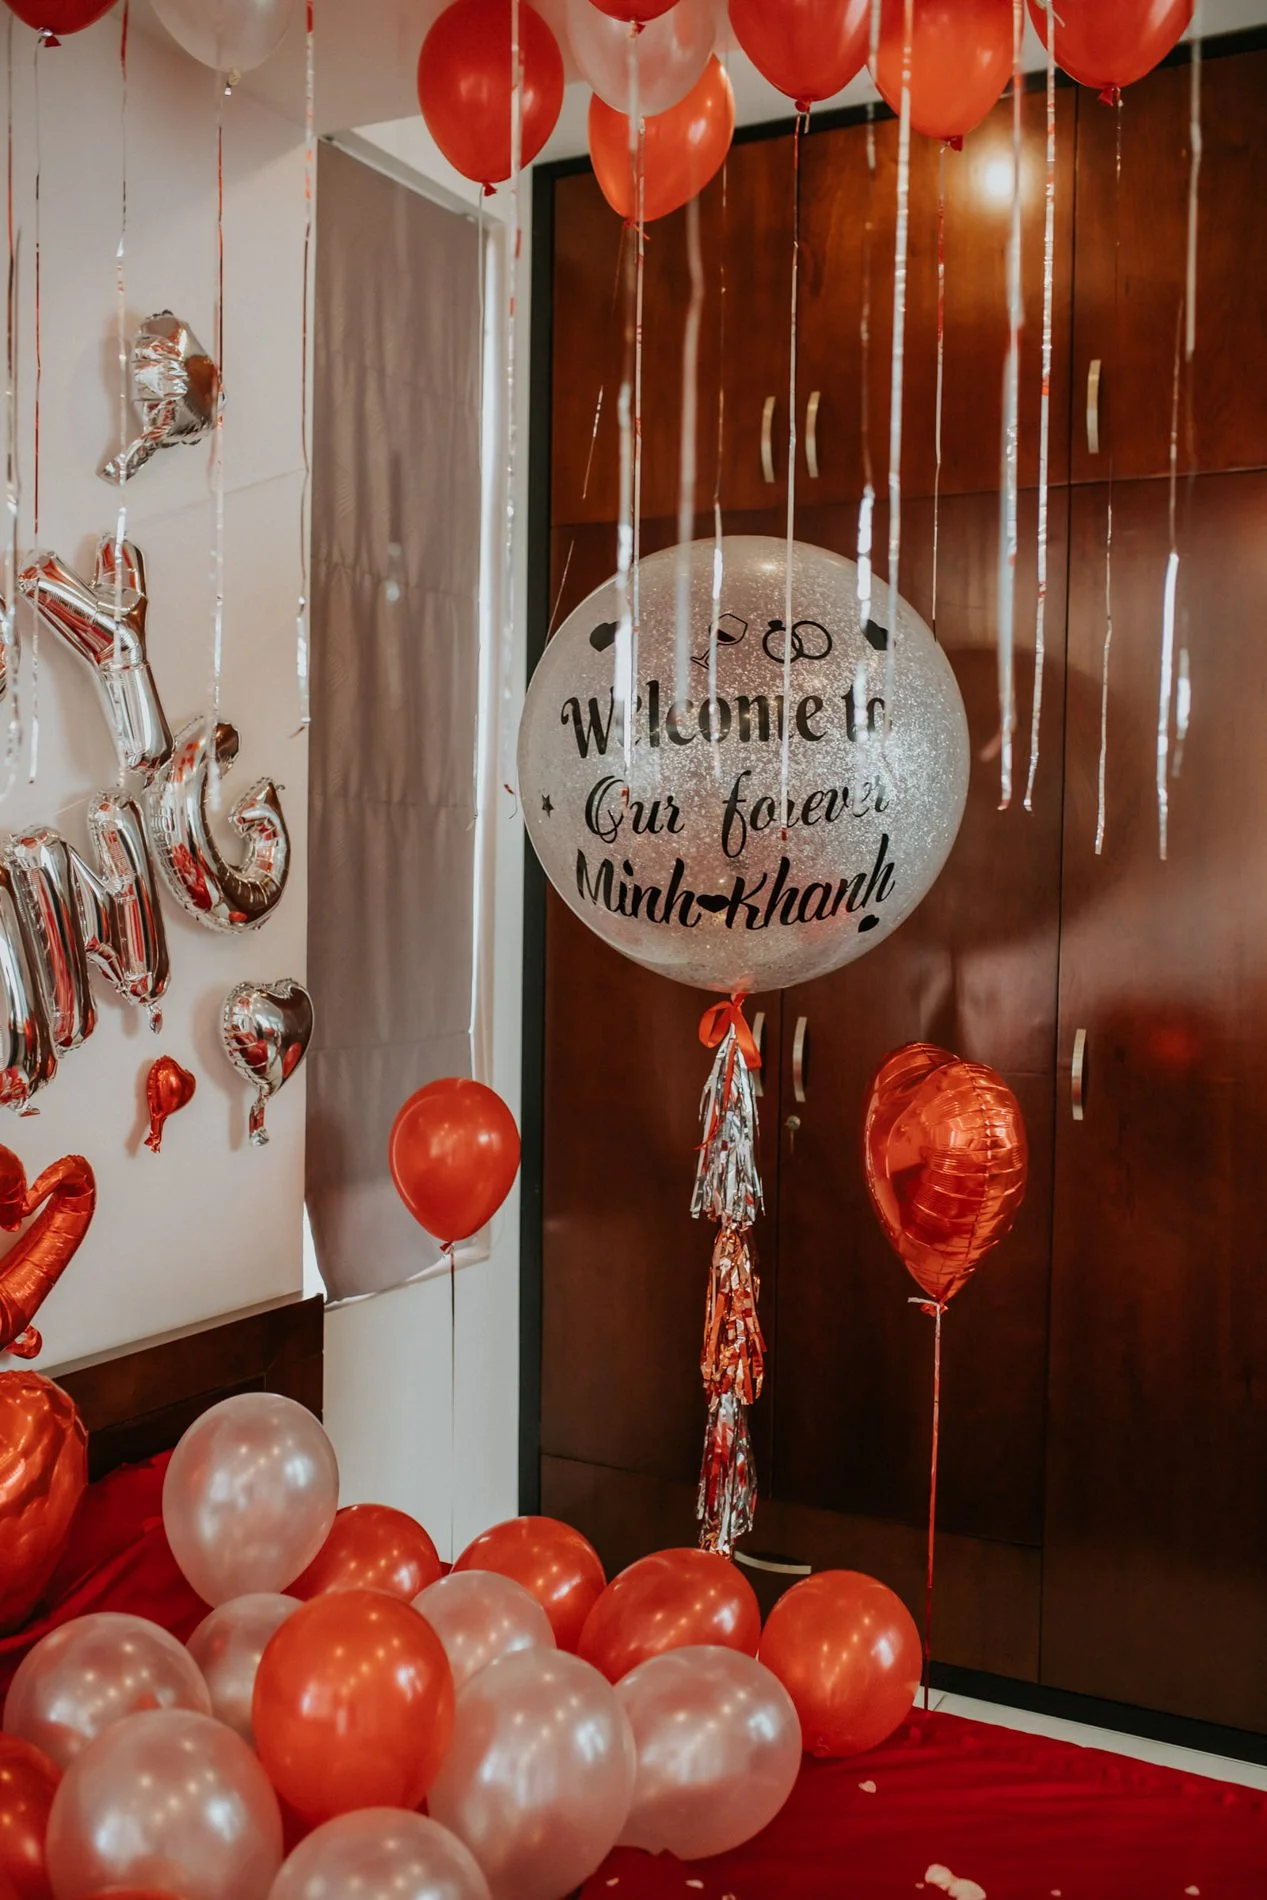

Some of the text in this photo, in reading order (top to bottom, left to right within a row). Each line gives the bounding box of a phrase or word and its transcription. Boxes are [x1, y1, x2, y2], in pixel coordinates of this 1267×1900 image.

[585, 775, 685, 844] Our
[576, 833, 896, 930] Minh Khanh
